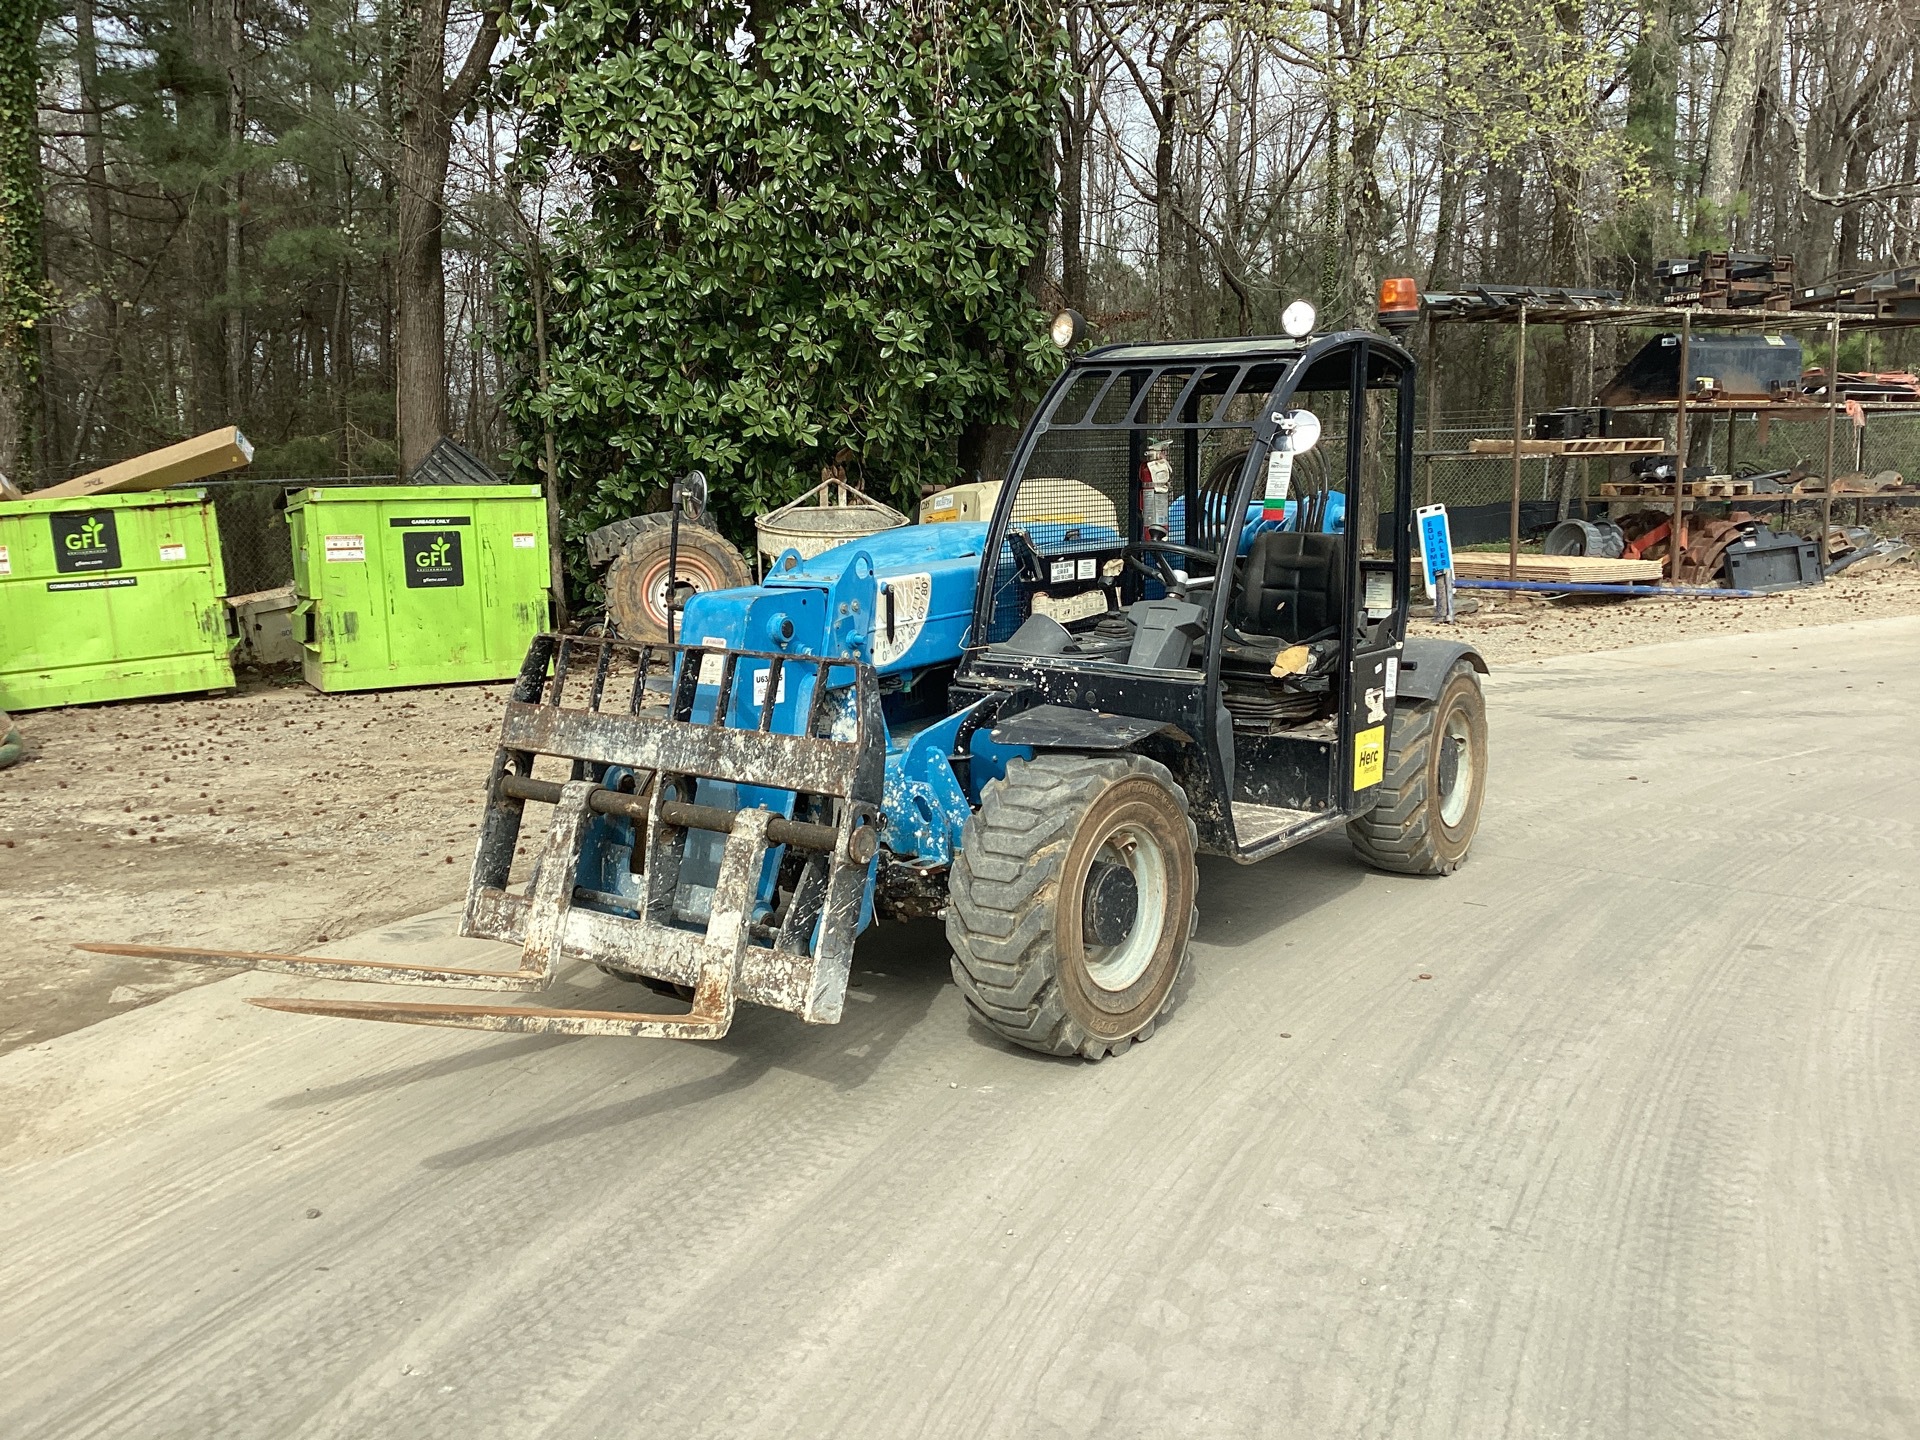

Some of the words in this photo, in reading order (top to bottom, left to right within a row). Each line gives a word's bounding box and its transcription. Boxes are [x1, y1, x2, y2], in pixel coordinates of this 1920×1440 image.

[65, 526, 106, 550] GFL
[1437, 530, 1446, 566] SALES
[415, 546, 451, 567] GFL
[1359, 749, 1379, 768] Herc
